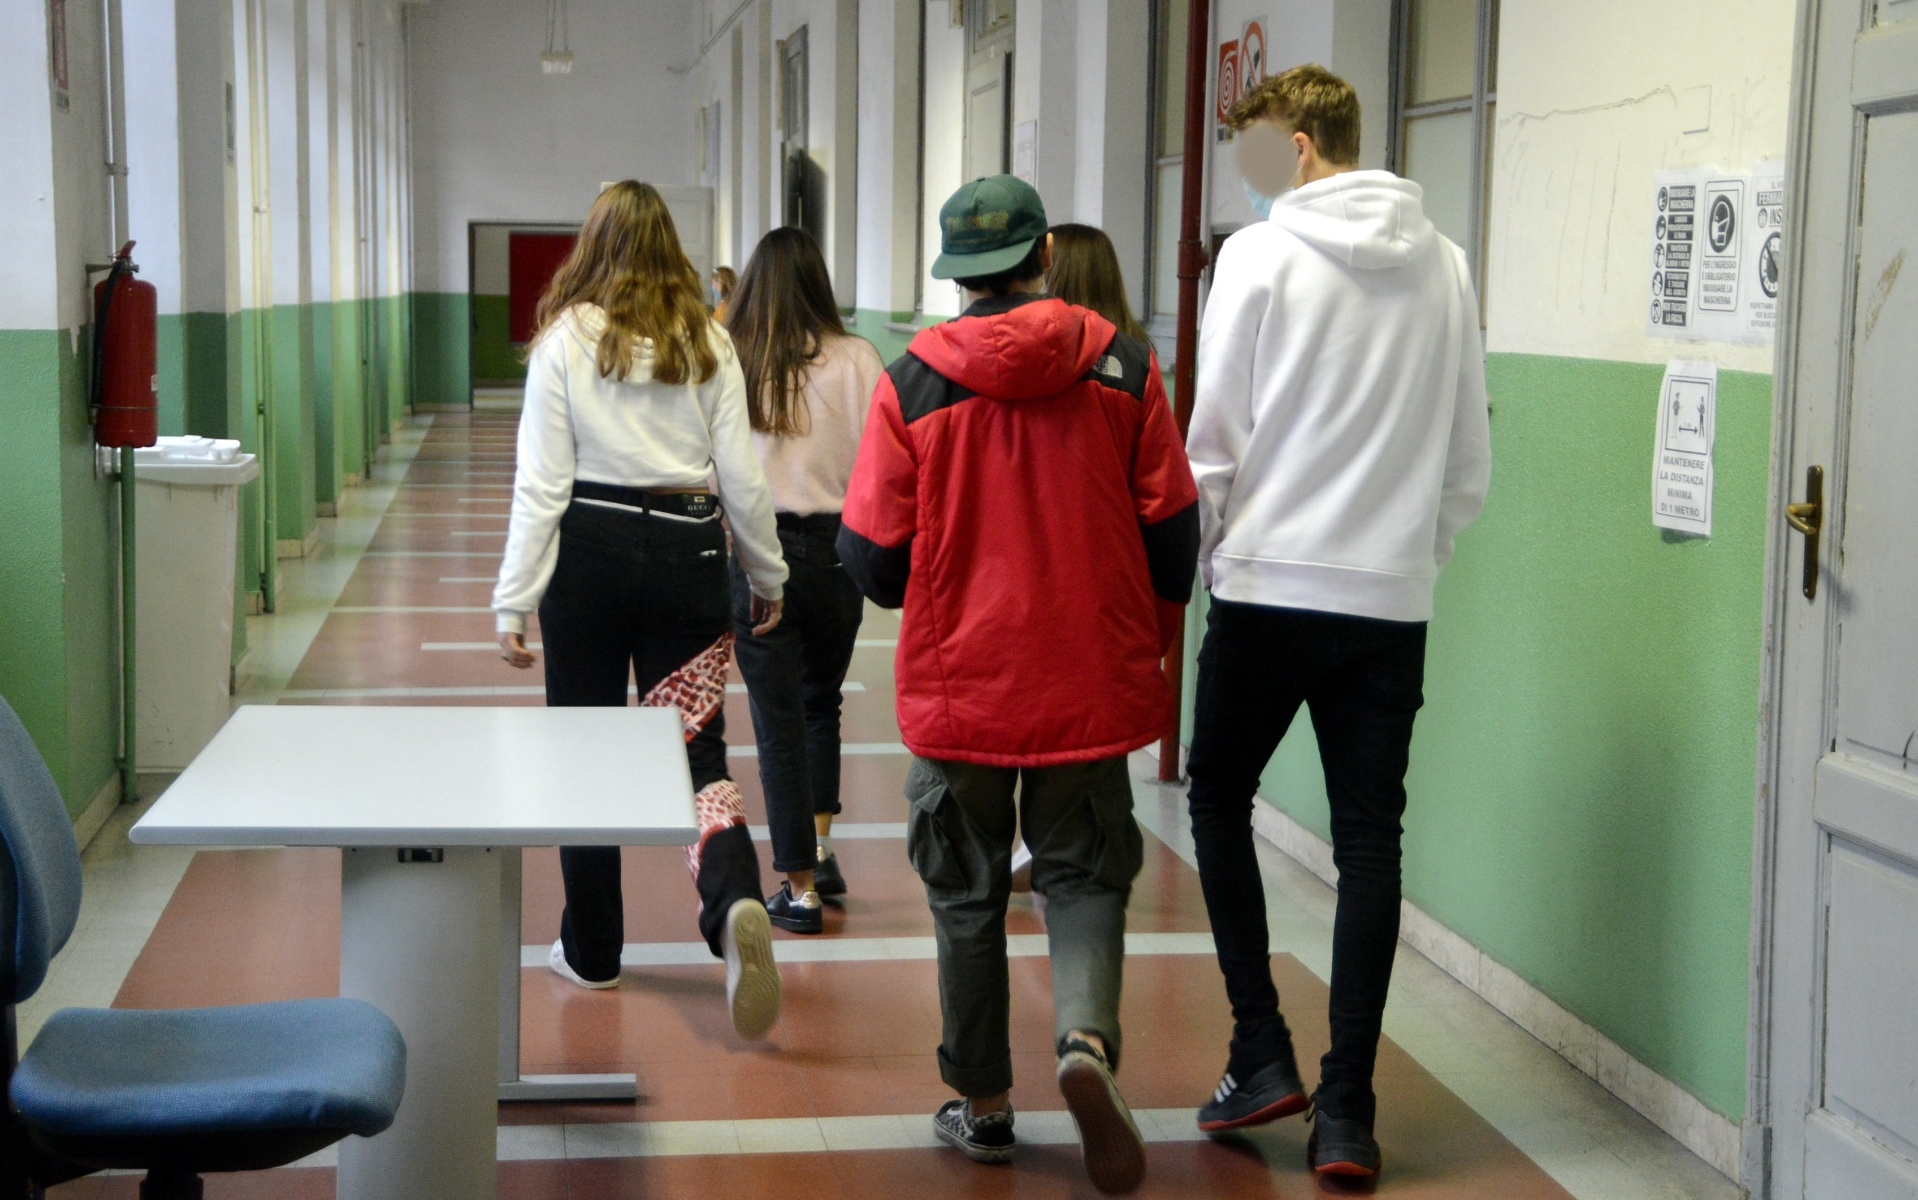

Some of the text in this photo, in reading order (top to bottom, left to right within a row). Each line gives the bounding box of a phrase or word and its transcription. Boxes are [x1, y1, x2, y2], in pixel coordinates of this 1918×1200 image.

[1770, 208, 1782, 224] INS
[1703, 284, 1733, 293] INDOSSARE LA
[1703, 296, 1731, 305] MASCHERINA
[1663, 455, 1705, 469] MANTENERE
[1660, 470, 1704, 486] LA DISTANZA
[1667, 487, 1693, 500] MINIMA
[1660, 502, 1667, 511] DI
[1674, 505, 1700, 517] METRO
